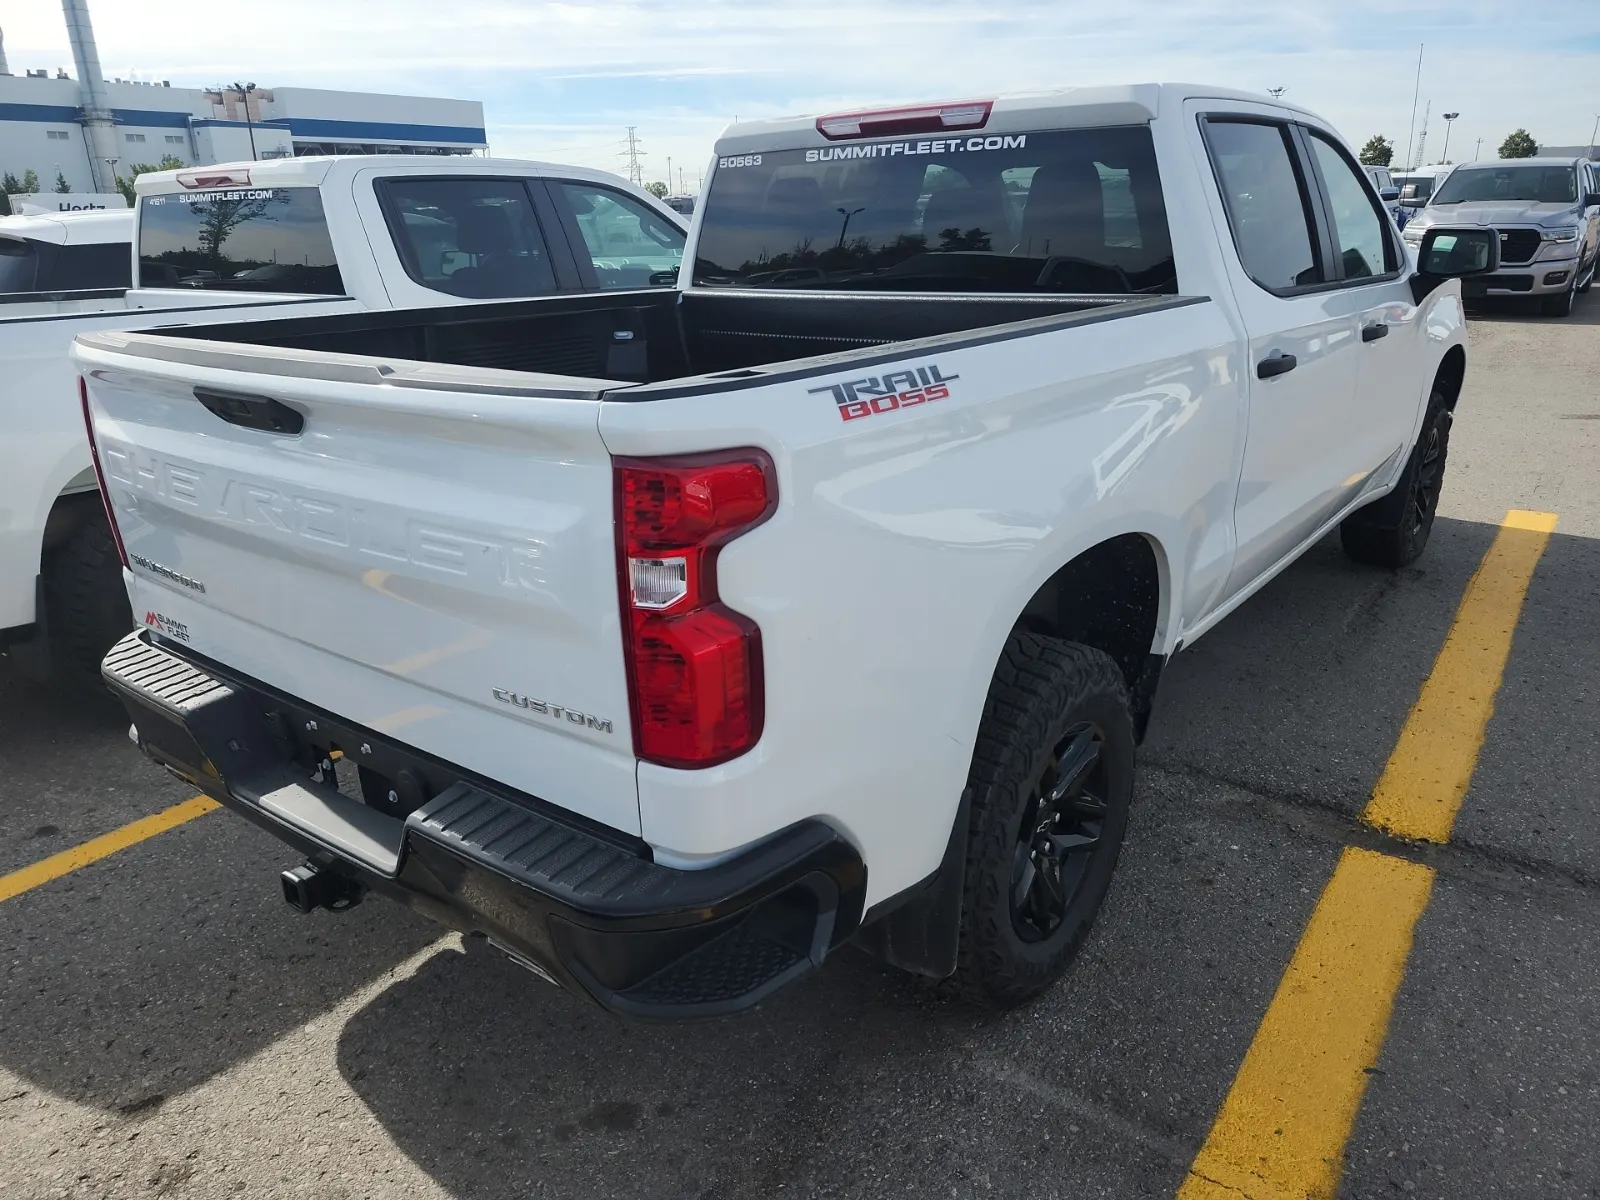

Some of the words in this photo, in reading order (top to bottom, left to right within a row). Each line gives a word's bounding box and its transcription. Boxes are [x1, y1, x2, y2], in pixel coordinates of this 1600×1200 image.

[806, 135, 1027, 162] SUMMITFLEET.COM
[719, 154, 762, 168] 50563
[179, 190, 273, 203] SUMMITFLEET.COM
[807, 365, 960, 404] TRAIL
[838, 383, 950, 422] BOSS
[157, 613, 188, 633] SUMMIT
[167, 626, 190, 642] FLEET
[492, 686, 613, 734] CUSTOM
